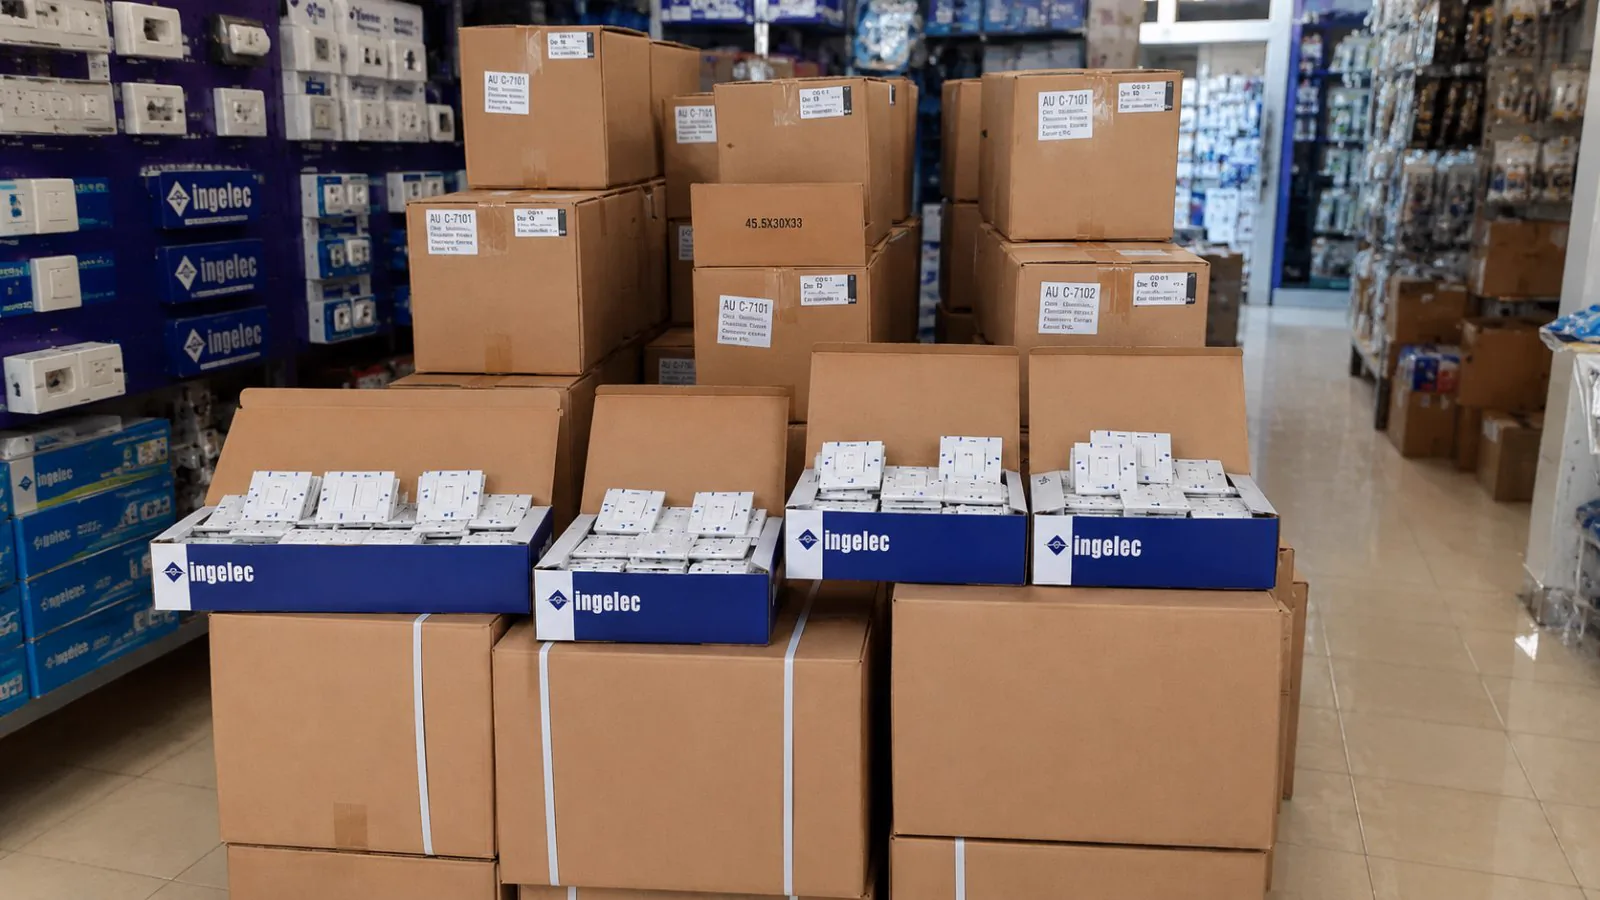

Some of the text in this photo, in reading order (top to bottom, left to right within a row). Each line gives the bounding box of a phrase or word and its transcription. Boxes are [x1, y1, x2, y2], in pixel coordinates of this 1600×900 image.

[488, 75, 526, 85] AU C-7101
[1042, 94, 1088, 106] AU C-7101
[192, 182, 252, 213] ingelec
[430, 213, 472, 224] AU C-7101
[745, 217, 803, 229] 45.5X30X33
[200, 253, 257, 284] ingelec
[1045, 286, 1096, 299] AU C-7102
[723, 300, 769, 314] AU C-7101
[207, 323, 262, 354] ingelec
[36, 466, 73, 488] ingelec
[824, 529, 890, 554] ingelec
[1074, 535, 1142, 559] ingelec
[189, 561, 255, 586] ingelec
[575, 590, 641, 615] ingelec
